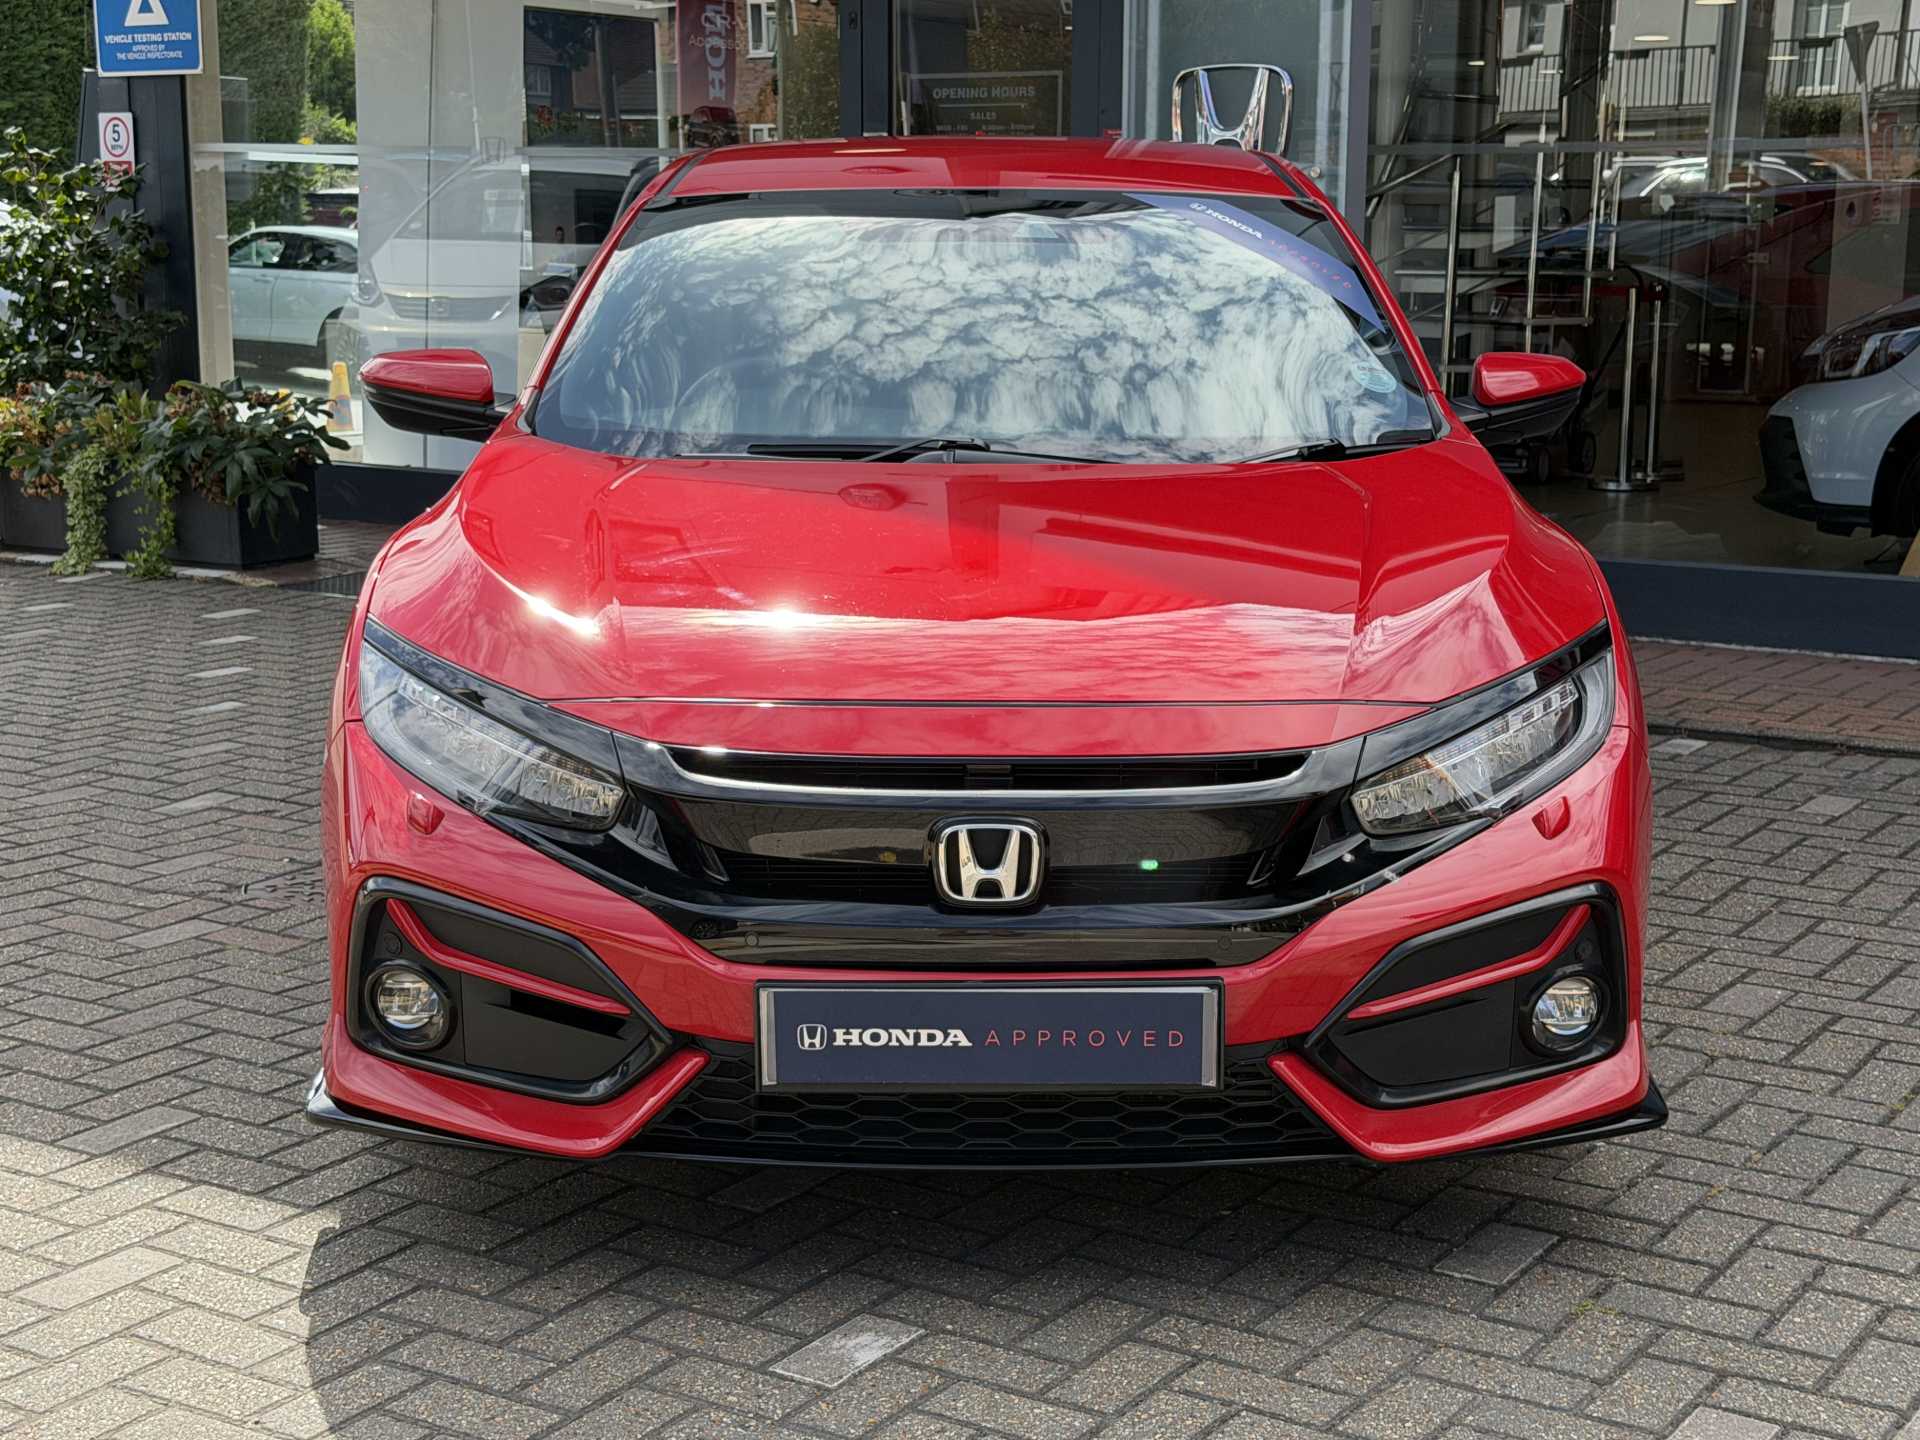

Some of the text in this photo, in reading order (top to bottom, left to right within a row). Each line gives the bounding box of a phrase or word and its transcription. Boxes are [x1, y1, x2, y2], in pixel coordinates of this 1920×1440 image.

[104, 31, 192, 44] VEHICLE TESTING STATION
[933, 86, 1036, 99] OPENING HOURS
[969, 111, 997, 121] SALES
[112, 123, 121, 142] 5
[1205, 207, 1264, 240] HONDA
[832, 1028, 973, 1047] HONDA
[984, 1029, 1185, 1047] APPROVED
